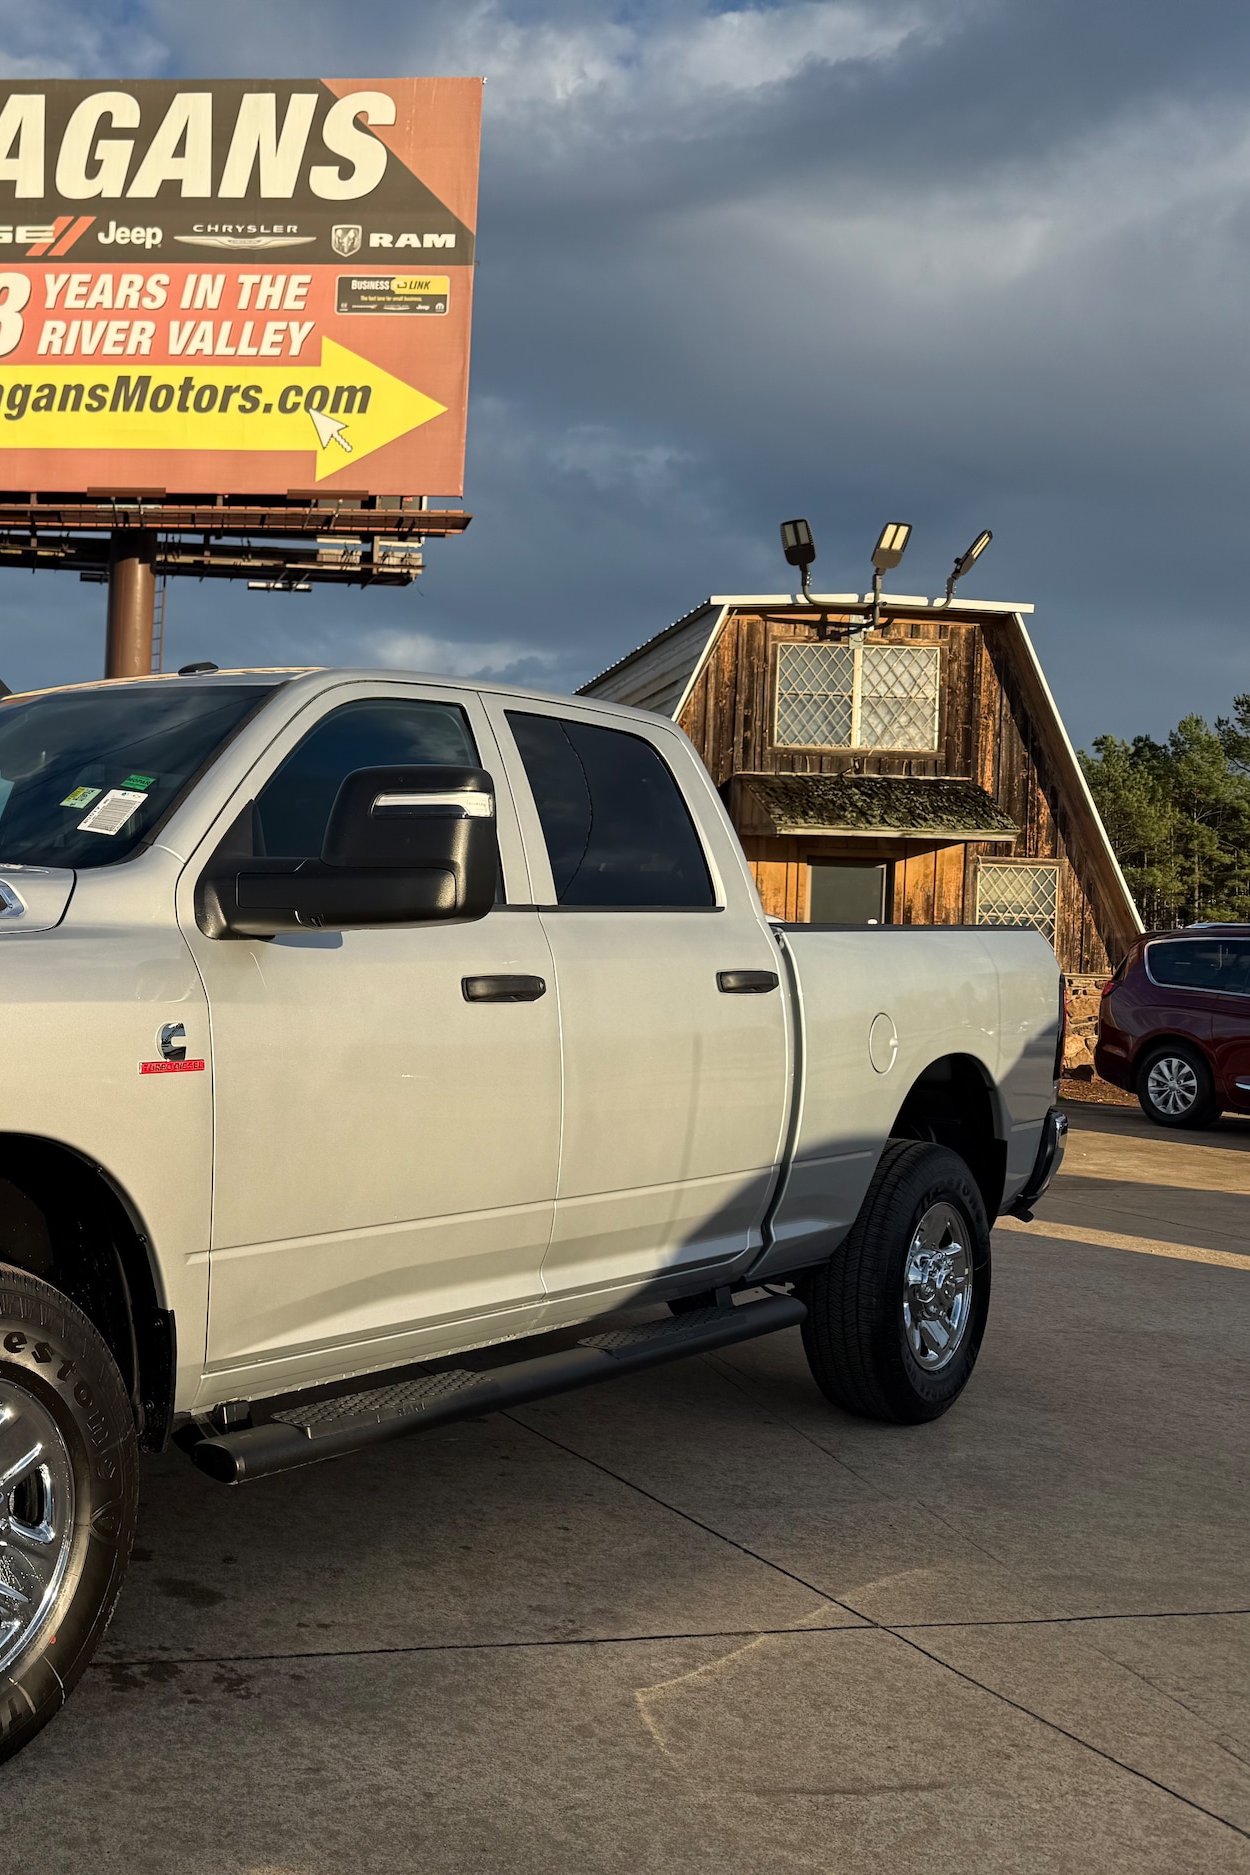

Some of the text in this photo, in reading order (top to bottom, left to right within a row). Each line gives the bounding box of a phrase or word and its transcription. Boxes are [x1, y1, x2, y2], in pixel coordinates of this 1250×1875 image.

[97, 220, 164, 250] Jeep
[192, 224, 299, 234] CHRYSLER
[369, 232, 456, 249] RAM
[44, 273, 313, 311] YEARS IN THE
[351, 280, 431, 290] BUSINESS LINK
[37, 320, 317, 357] RIVER VALLEY
[143, 1061, 203, 1072] TURBO DIESEL
